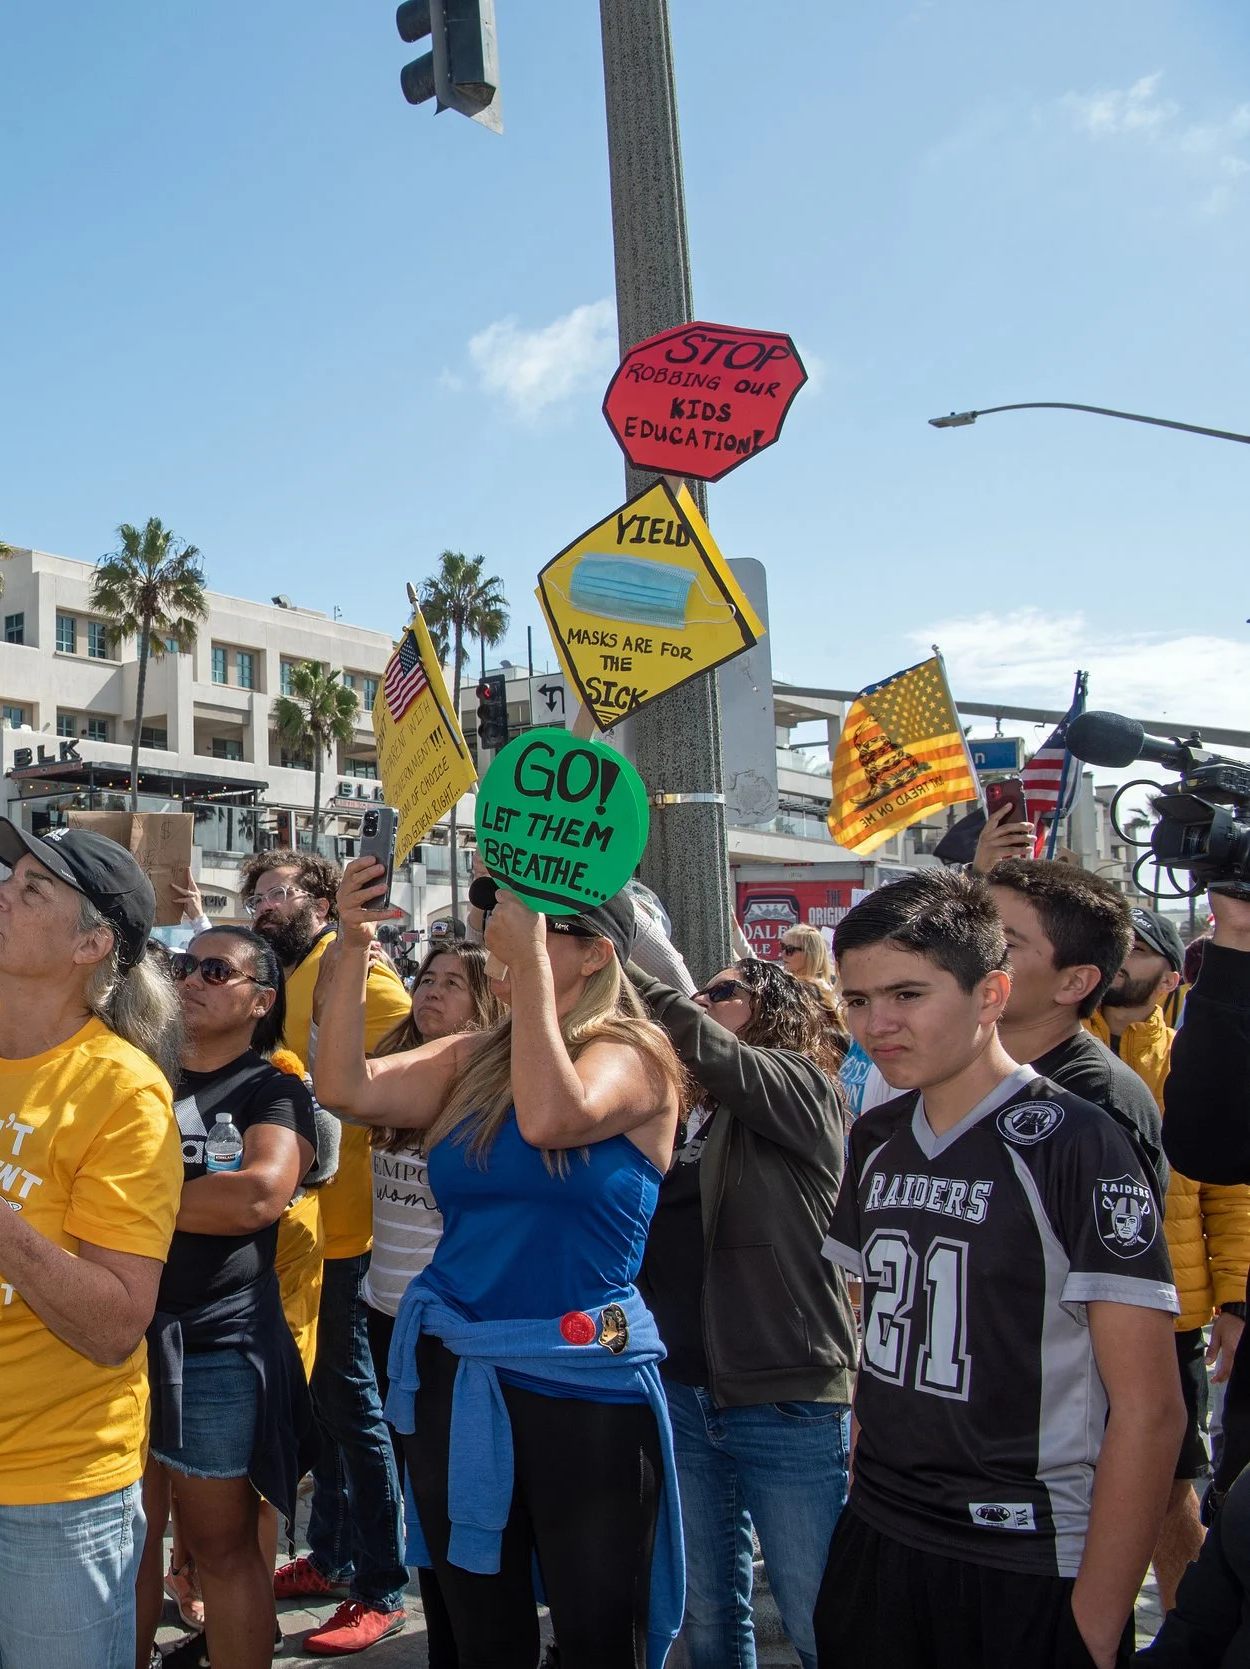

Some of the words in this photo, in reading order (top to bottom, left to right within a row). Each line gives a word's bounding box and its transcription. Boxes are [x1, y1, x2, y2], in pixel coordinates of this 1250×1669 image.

[665, 333, 790, 371] STOP
[625, 363, 721, 391] ROBBING
[734, 379, 781, 398] OUR
[669, 397, 732, 422] KIDS
[624, 416, 765, 454] EDUCATION!
[616, 513, 691, 547] YIELD
[567, 628, 618, 648] MASKS
[622, 636, 653, 654] ARE
[661, 642, 693, 661] FOR
[599, 655, 632, 672] THE
[585, 676, 649, 711] SICK
[409, 699, 432, 736] WITH
[14, 739, 81, 766] BLK
[420, 756, 450, 796] CHOICE
[514, 741, 620, 815] GO!
[411, 806, 433, 839] GIVEN
[481, 802, 521, 833] LET
[527, 812, 614, 852] THEM
[483, 838, 607, 901] BREATHE...
[826, 890, 842, 906] THE
[864, 1172, 994, 1224] RAIDERS
[1101, 1183, 1150, 1199] RAIDERS
[861, 1228, 972, 1402] 21
[1016, 1508, 1029, 1527] YM
